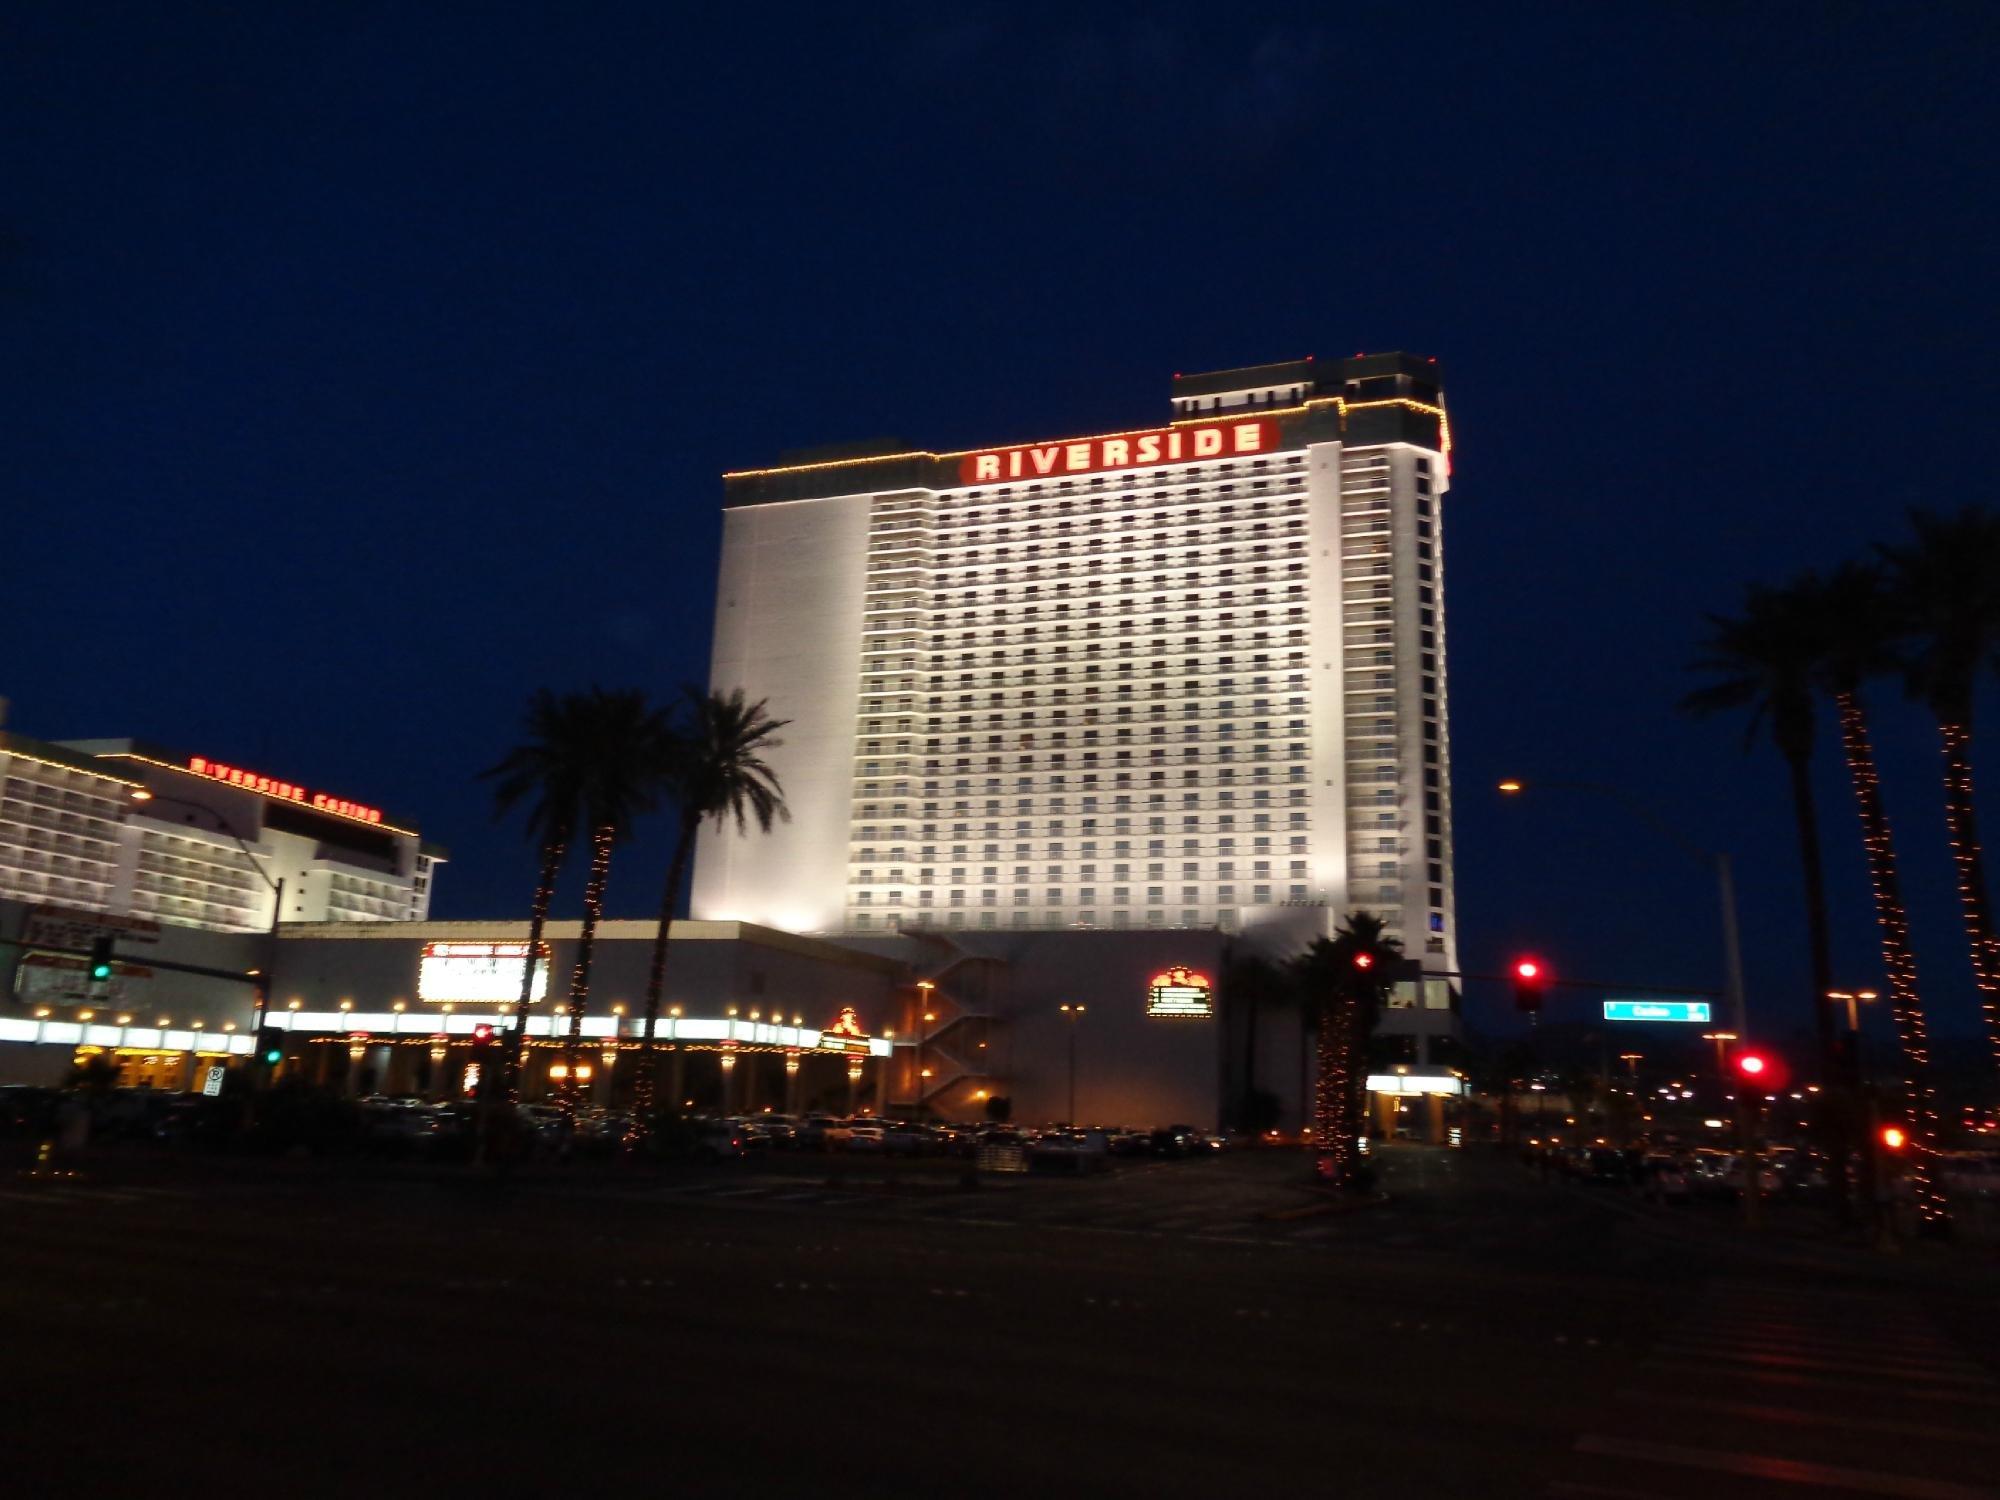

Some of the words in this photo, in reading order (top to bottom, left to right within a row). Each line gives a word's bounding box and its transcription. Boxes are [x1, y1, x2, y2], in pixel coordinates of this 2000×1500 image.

[976, 424, 1261, 480] RIVERSIDE
[190, 758, 304, 801] RIVERSIDE
[313, 794, 381, 823] CASINO
